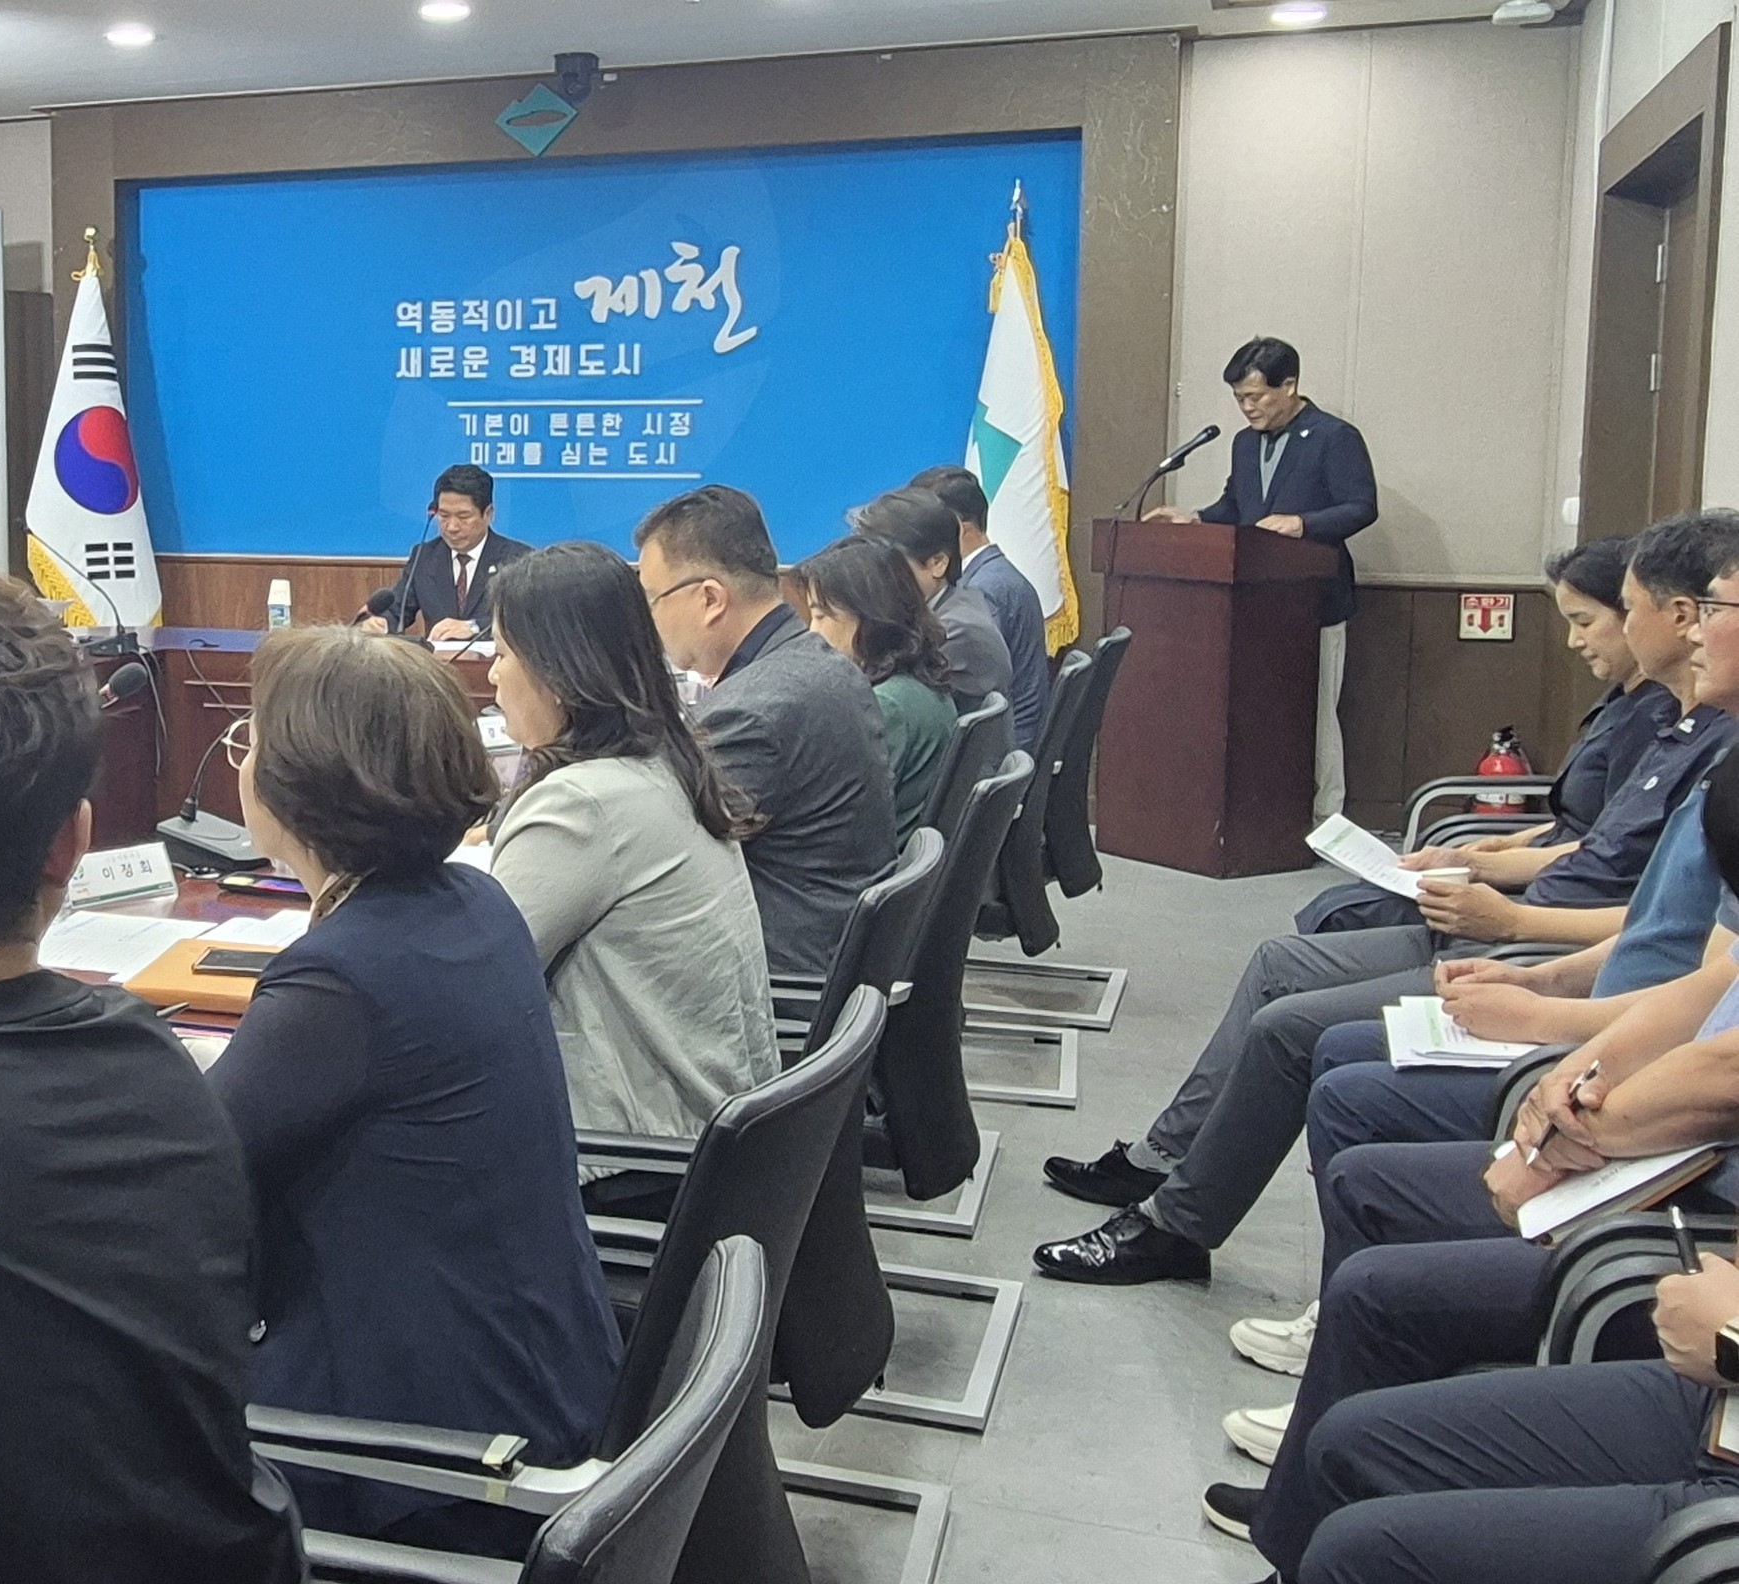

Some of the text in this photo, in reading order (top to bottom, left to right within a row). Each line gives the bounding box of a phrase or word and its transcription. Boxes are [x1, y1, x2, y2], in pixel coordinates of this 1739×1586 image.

[395, 241, 758, 354] 역동적이고 제천
[395, 343, 643, 379] 새로운 경제도시
[458, 412, 693, 438] 기본이 튼튼한 시정
[469, 441, 677, 467] 미래를 심는 도시
